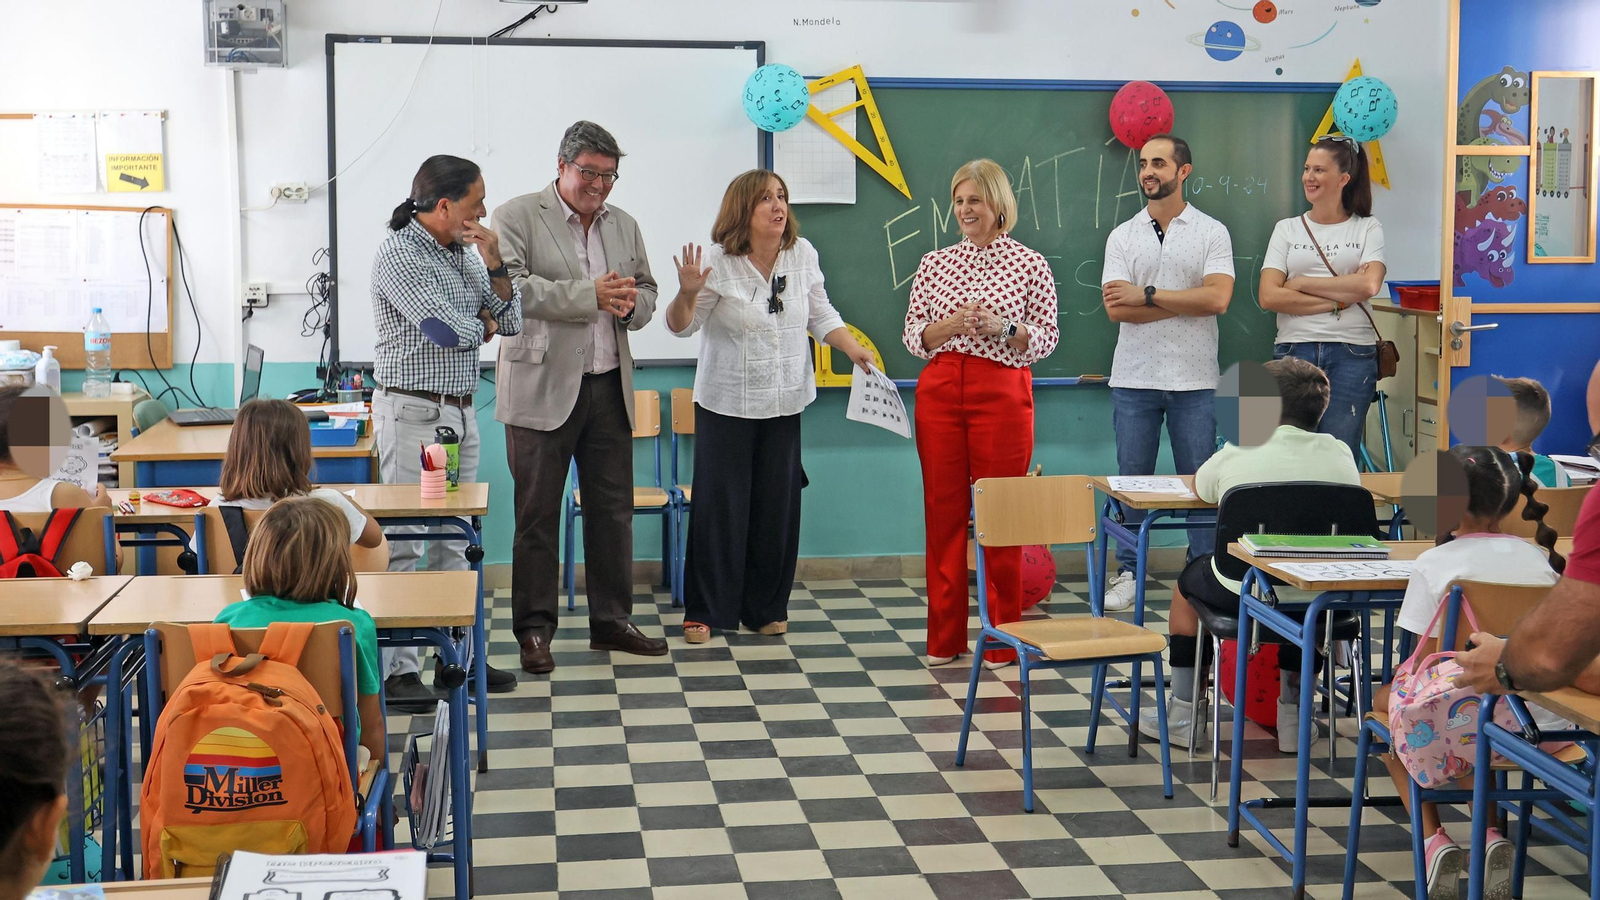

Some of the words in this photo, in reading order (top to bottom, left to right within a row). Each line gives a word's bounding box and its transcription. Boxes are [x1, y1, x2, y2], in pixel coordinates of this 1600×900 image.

[1265, 54, 1285, 63] Uranus
[108, 154, 159, 162] INFORMACIÓN
[204, 766, 284, 794] Miller
[186, 784, 284, 807] Division
